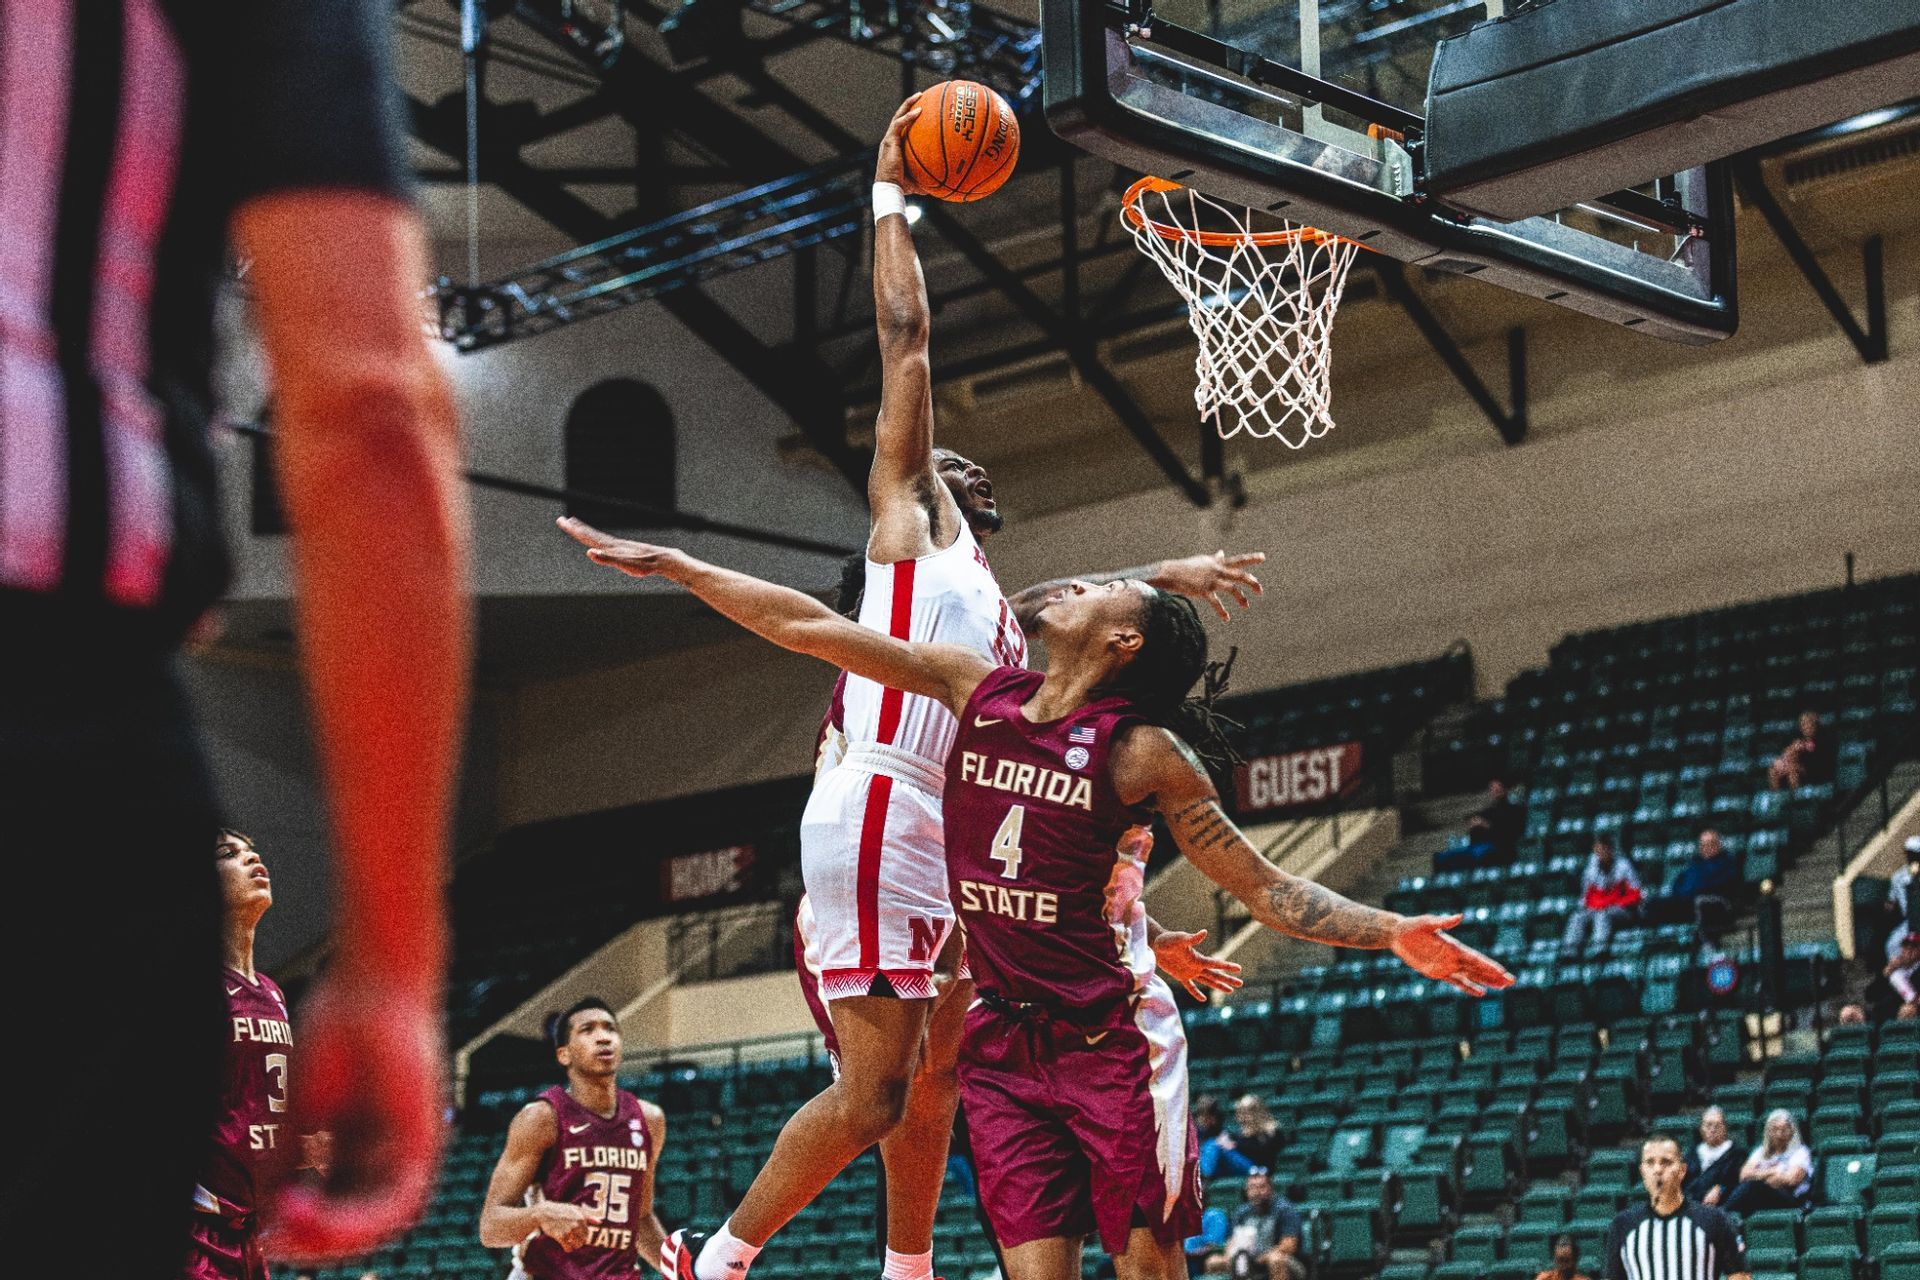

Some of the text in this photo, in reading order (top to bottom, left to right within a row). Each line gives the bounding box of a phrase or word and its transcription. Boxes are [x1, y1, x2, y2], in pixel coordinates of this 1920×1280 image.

[960, 751, 1092, 811] FLORIDA
[1249, 747, 1345, 808] GUEST
[989, 804, 1025, 879] 4
[959, 880, 1058, 923] STATE
[907, 916, 947, 963] N
[265, 1053, 288, 1113] 3
[564, 1146, 648, 1171] FLORIDA
[581, 1171, 632, 1224] 35
[586, 1227, 632, 1250] TATE
